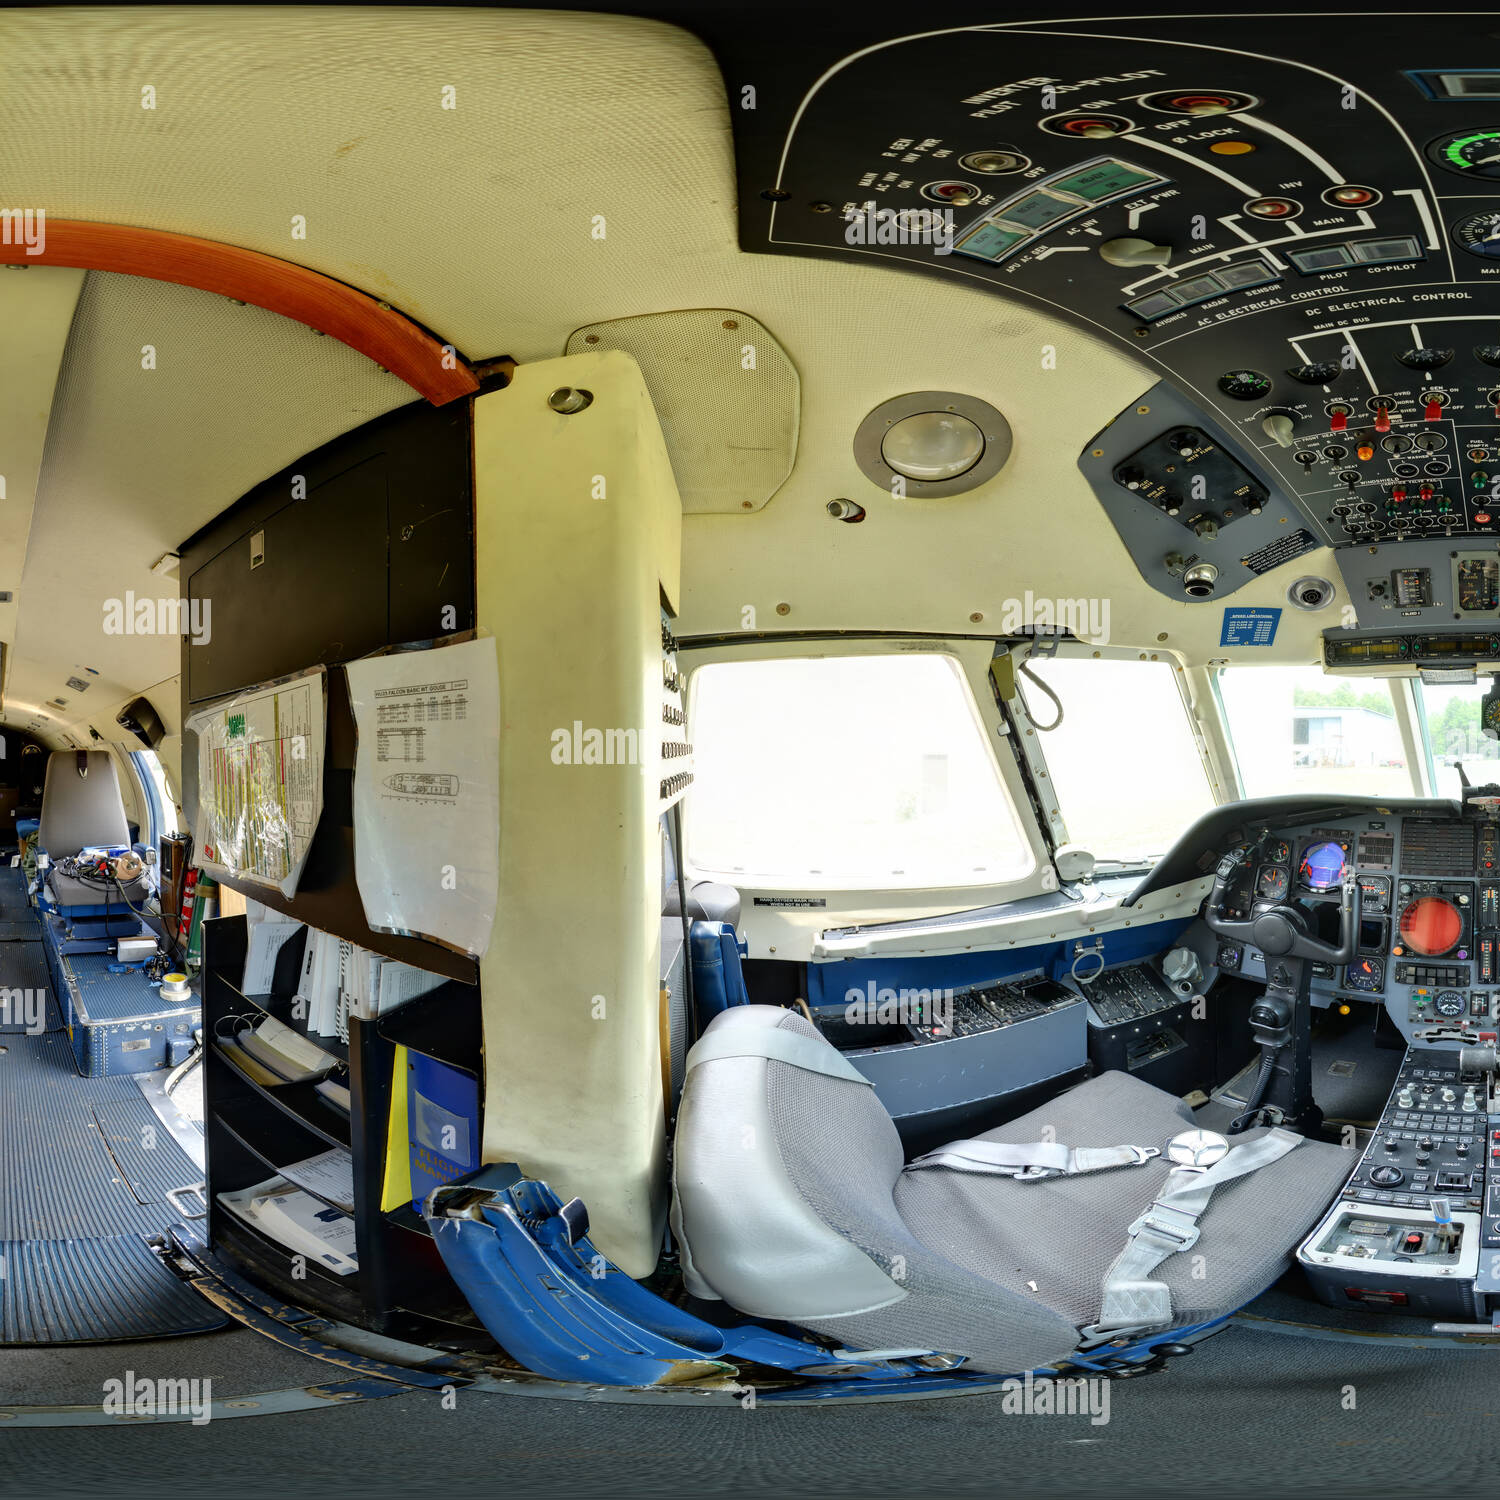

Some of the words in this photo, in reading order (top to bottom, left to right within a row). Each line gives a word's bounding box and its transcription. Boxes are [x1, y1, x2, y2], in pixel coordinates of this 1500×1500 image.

[960, 76, 1062, 105] INVERTER
[970, 100, 1023, 119] PILOT
[1050, 69, 1167, 95] CO-PILOT
[1081, 99, 1116, 111] ON
[1154, 118, 1192, 131] OFF
[1190, 127, 1240, 141] LOCK
[888, 138, 916, 151] GEN
[914, 138, 944, 152] PWR
[932, 149, 954, 158] ON
[1023, 166, 1048, 179] OFF
[875, 183, 891, 192] AC
[897, 180, 914, 189] ON
[1279, 180, 1303, 190] INV
[977, 194, 997, 206] OFF
[1124, 199, 1147, 211] EXT
[1150, 189, 1181, 201] PWR
[1066, 226, 1082, 236] AC
[1081, 218, 1099, 229] INV
[1312, 217, 1345, 227] MAIN
[1189, 243, 1215, 255] MAIN
[1005, 262, 1021, 274] APU
[1020, 254, 1032, 264] AC
[1031, 244, 1049, 256] GEN
[1367, 263, 1417, 274] CO-PILOT
[1319, 271, 1349, 281] PILOT
[1245, 283, 1282, 297] SENSOR
[1197, 317, 1213, 328] AC
[1215, 297, 1286, 320] ELECTRICAL
[1291, 285, 1350, 301] CONTROL
[1201, 297, 1230, 311] RADAR
[1305, 307, 1322, 317] DC
[1328, 295, 1405, 313] ELECTRICAL
[1412, 291, 1473, 302] CONTROL
[1155, 312, 1188, 329] AVIONICS
[1313, 322, 1335, 330] MAIN
[1337, 319, 1349, 327] DC
[1353, 316, 1370, 324] BUS
